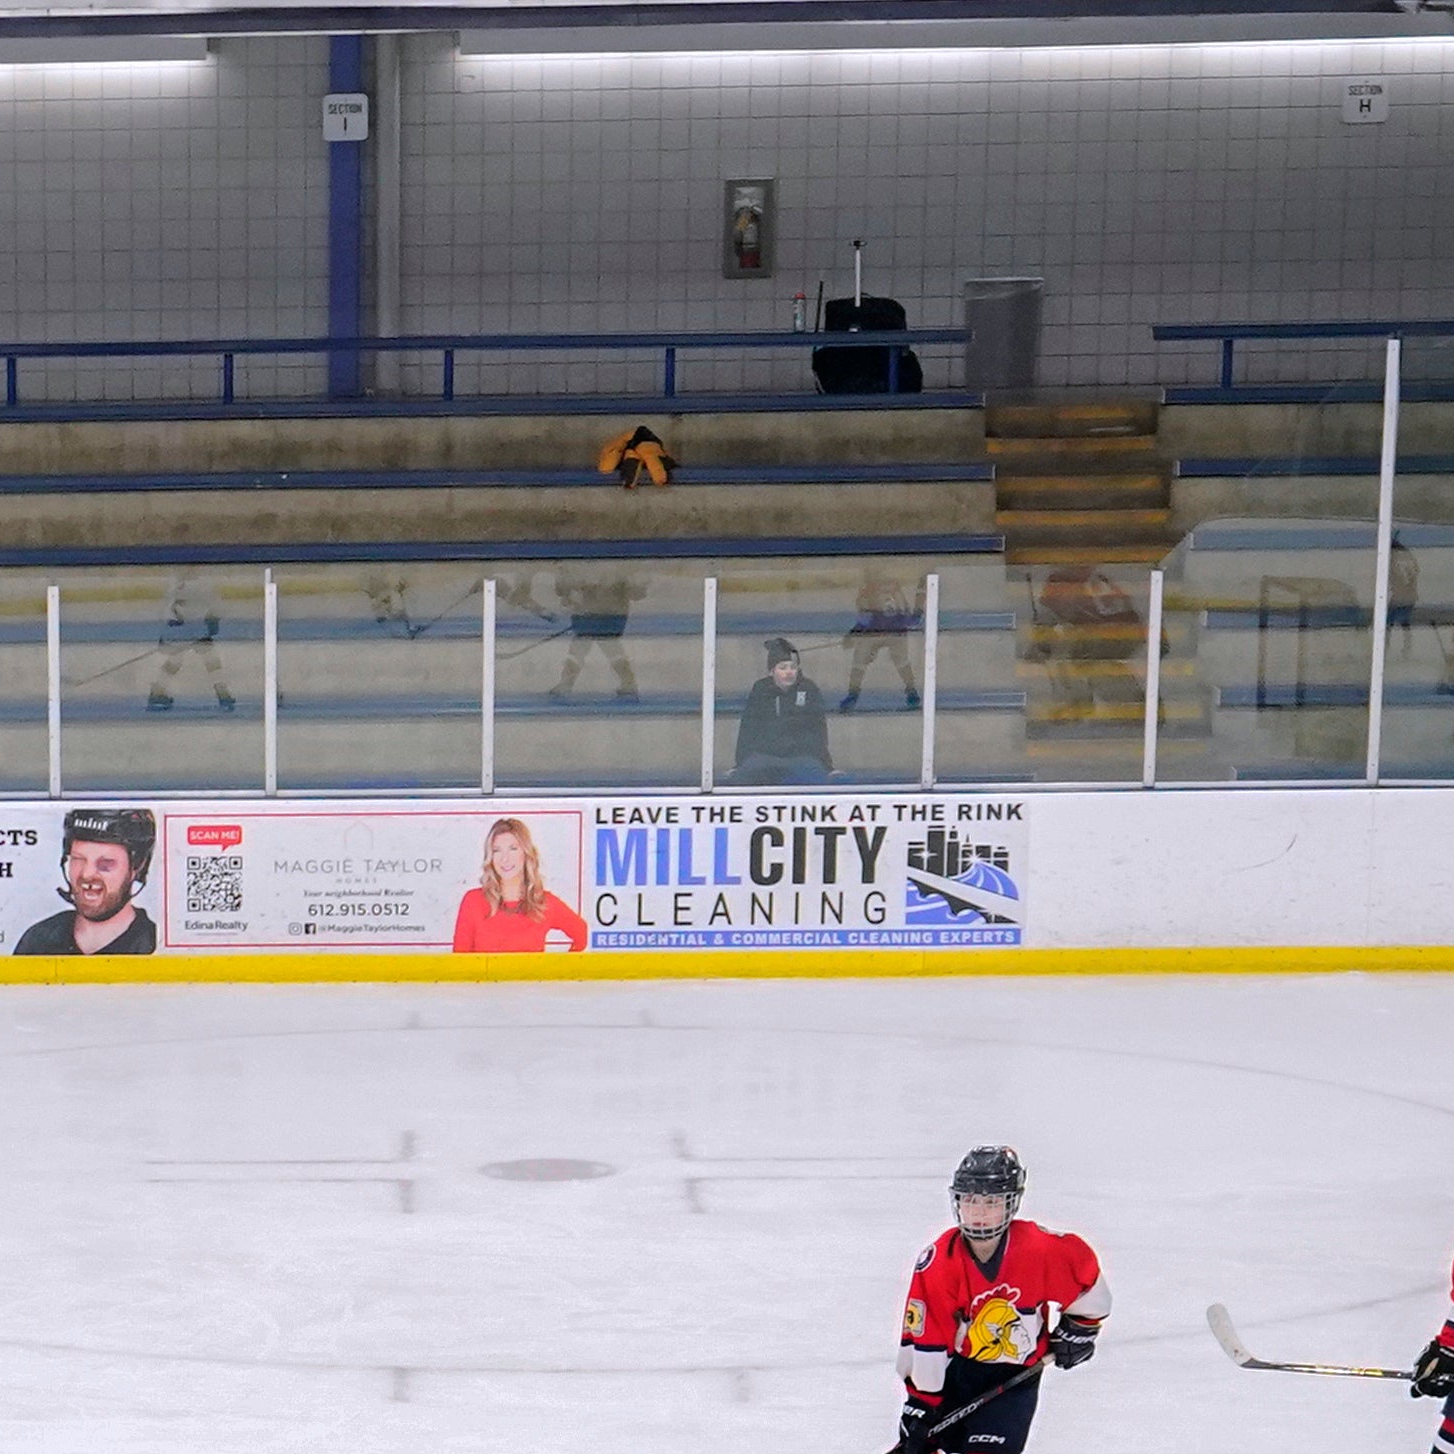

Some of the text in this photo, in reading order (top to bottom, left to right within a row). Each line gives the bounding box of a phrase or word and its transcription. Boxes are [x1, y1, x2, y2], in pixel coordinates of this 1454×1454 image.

[1348, 85, 1383, 95] SECTION
[328, 103, 362, 114] SECTION
[1359, 98, 1371, 112] H
[595, 803, 1023, 825] LEAVE THE STINK AT THE RINK
[190, 830, 239, 840] SCAN ME!
[274, 858, 443, 874] MAGGIE TAYLOR
[308, 903, 410, 916] 612.915.0512
[595, 890, 887, 926] CLEANING
[597, 930, 1015, 946] RESIDENTIAL & COMMERCIAL CLEANING EXPERTS
[969, 1434, 1005, 1444] CCM
